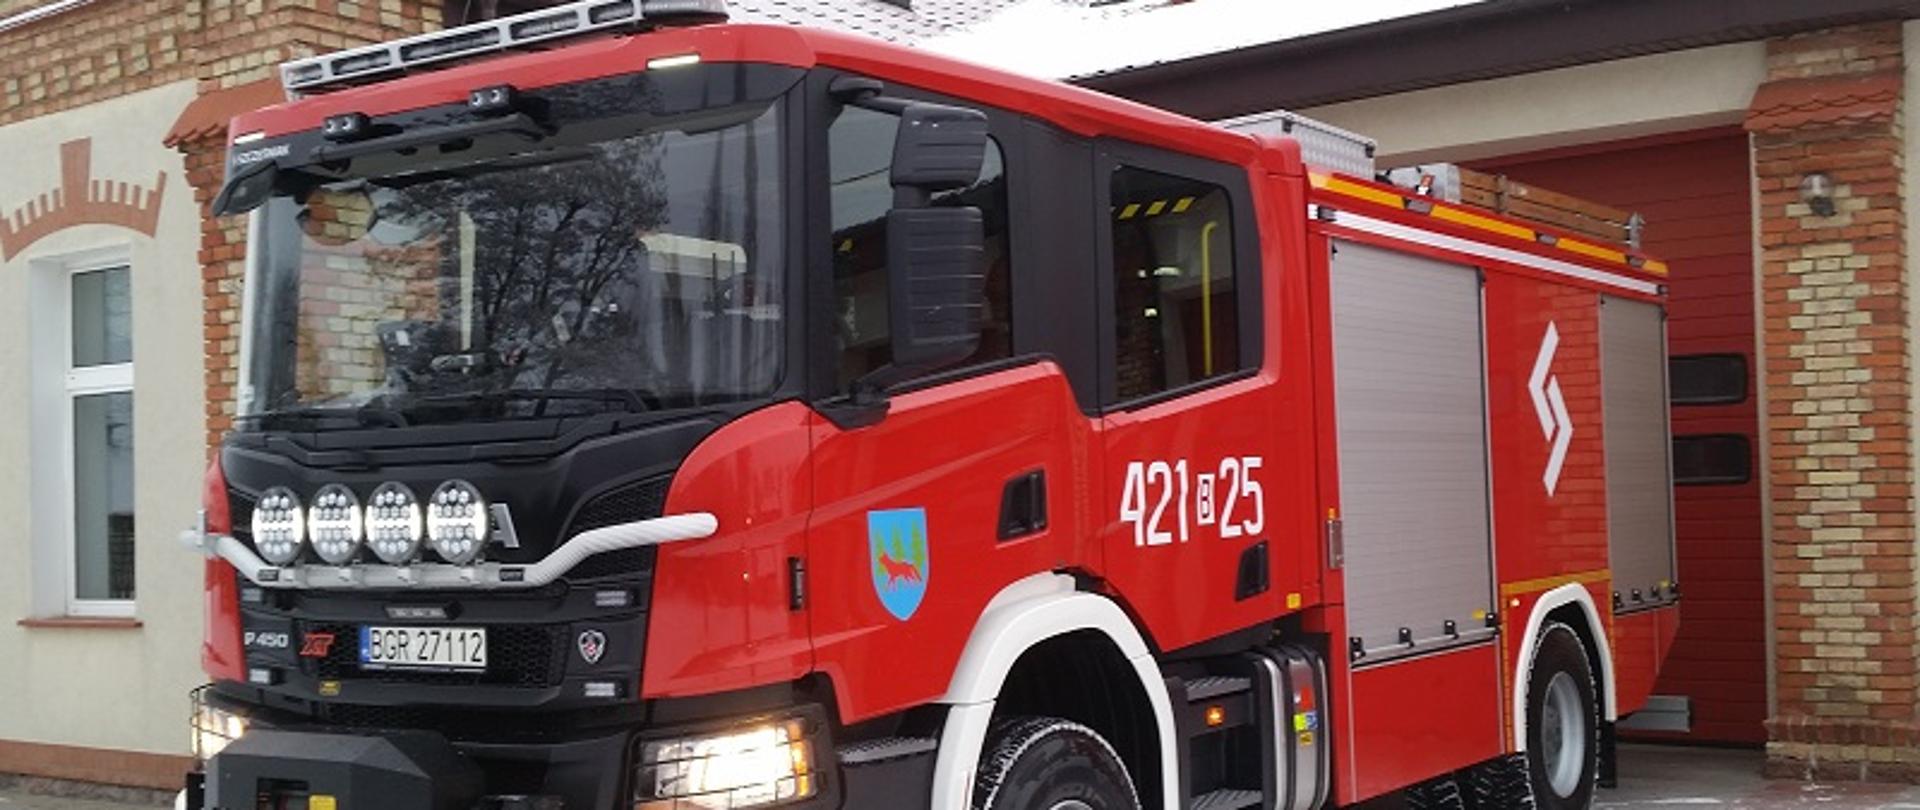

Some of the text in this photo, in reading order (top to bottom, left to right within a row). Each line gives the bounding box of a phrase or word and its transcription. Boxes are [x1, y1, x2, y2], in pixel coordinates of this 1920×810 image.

[1120, 458, 1189, 546] 421
[1219, 456, 1264, 538] 25
[244, 631, 289, 648] P 450
[372, 629, 484, 663] BGR 27112
